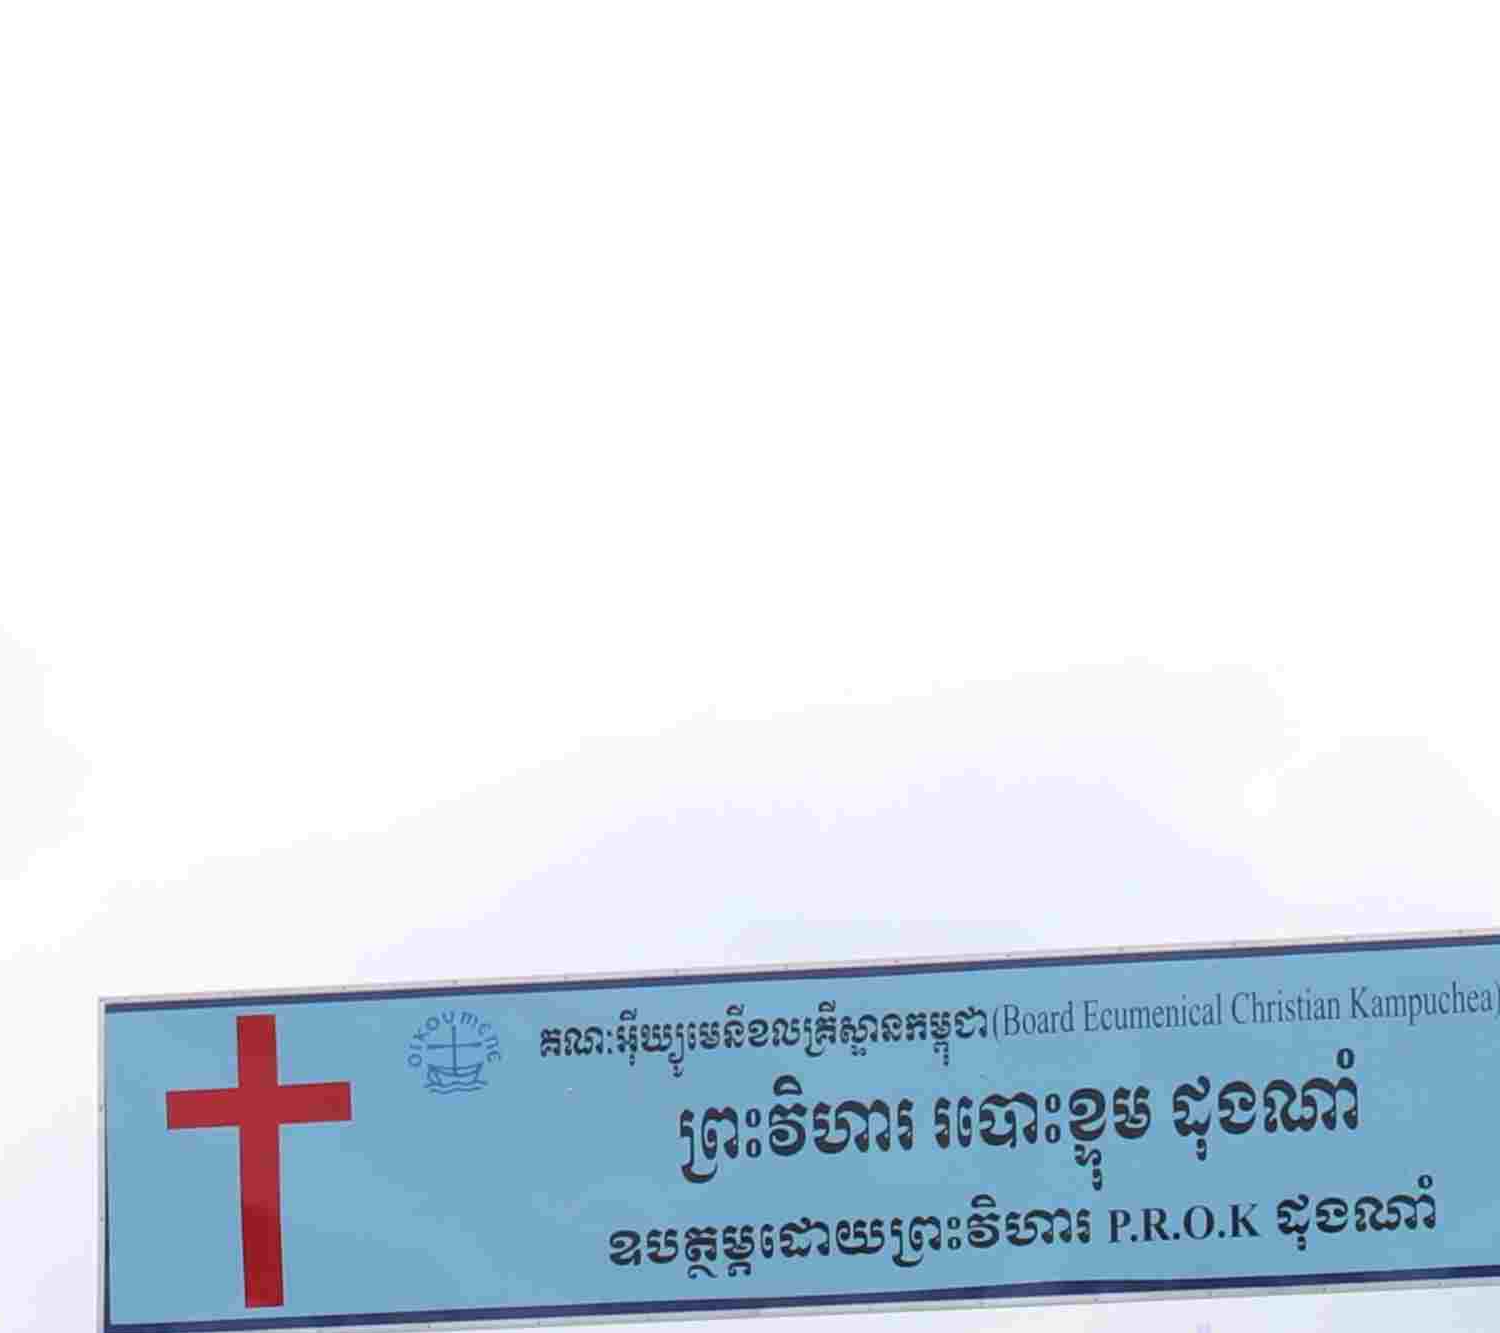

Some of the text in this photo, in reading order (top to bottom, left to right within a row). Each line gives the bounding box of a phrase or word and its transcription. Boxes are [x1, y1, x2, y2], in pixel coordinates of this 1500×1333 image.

[1083, 993, 1222, 1032] Ecumenical
[1232, 988, 1342, 1024] Christian
[1108, 1202, 1261, 1244] P.R.O.K
